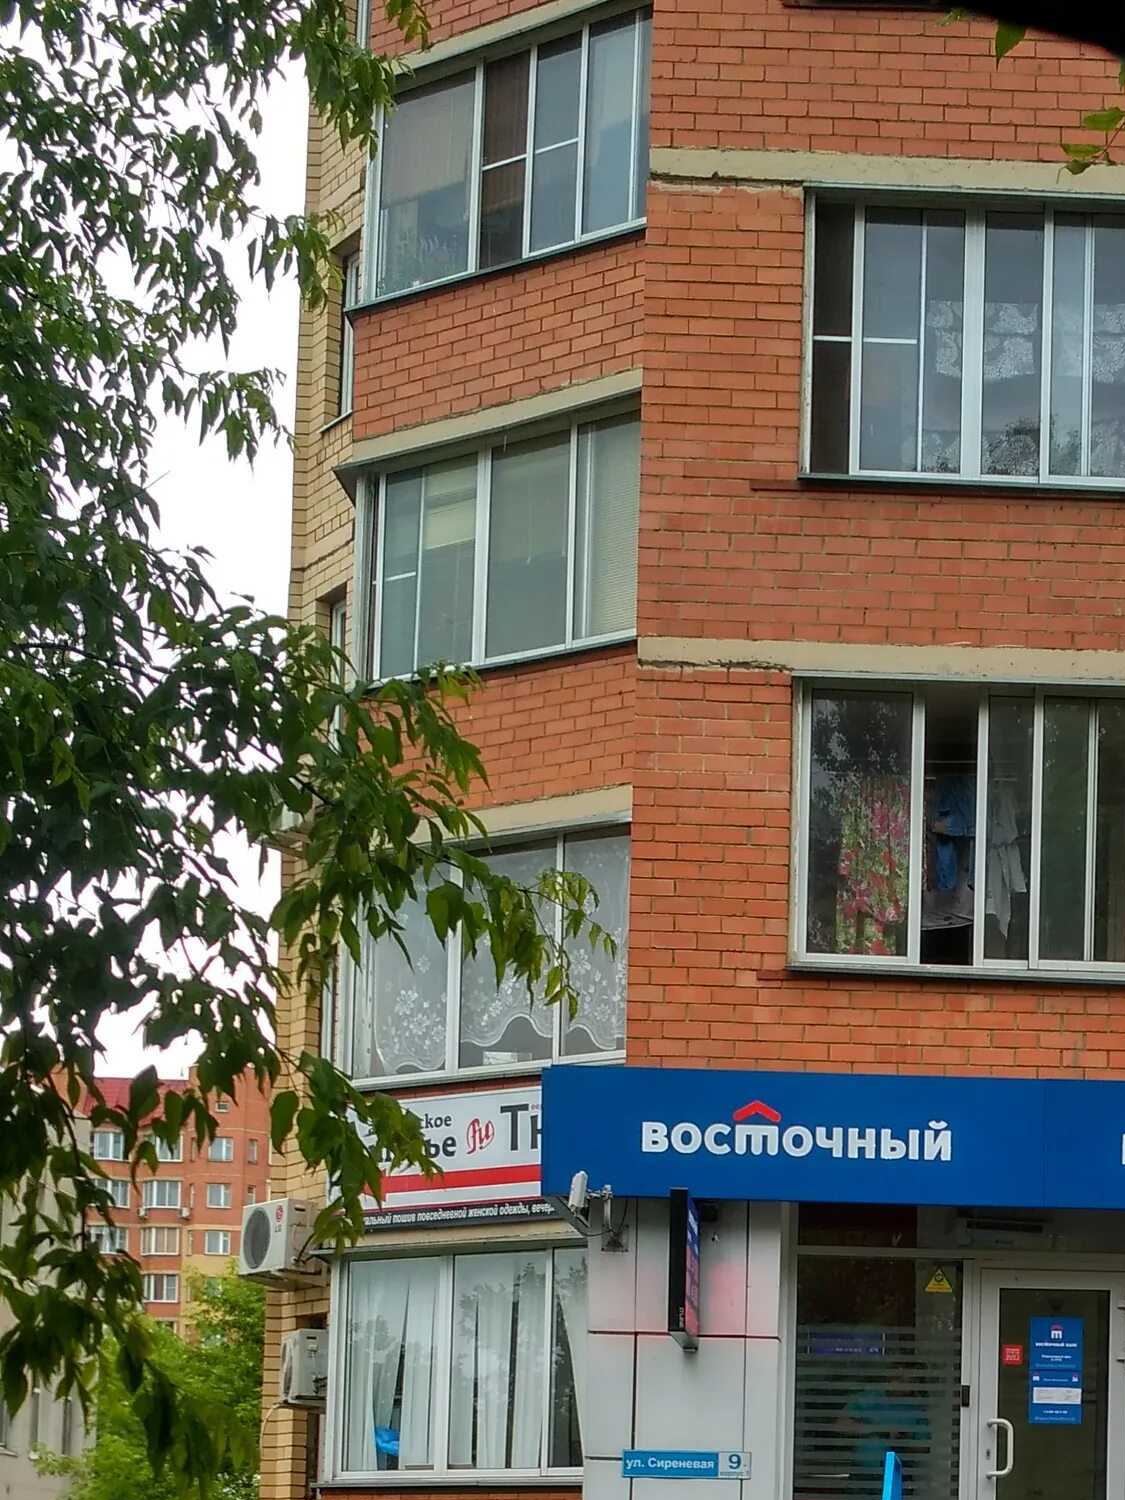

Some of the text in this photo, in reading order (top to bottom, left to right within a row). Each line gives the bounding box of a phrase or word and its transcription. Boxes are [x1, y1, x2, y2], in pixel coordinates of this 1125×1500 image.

[640, 1119, 952, 1162] ВОСТОЧНЫЙ
[625, 1457, 715, 1471] ул. Сиреневая
[728, 1453, 742, 1470] 9
